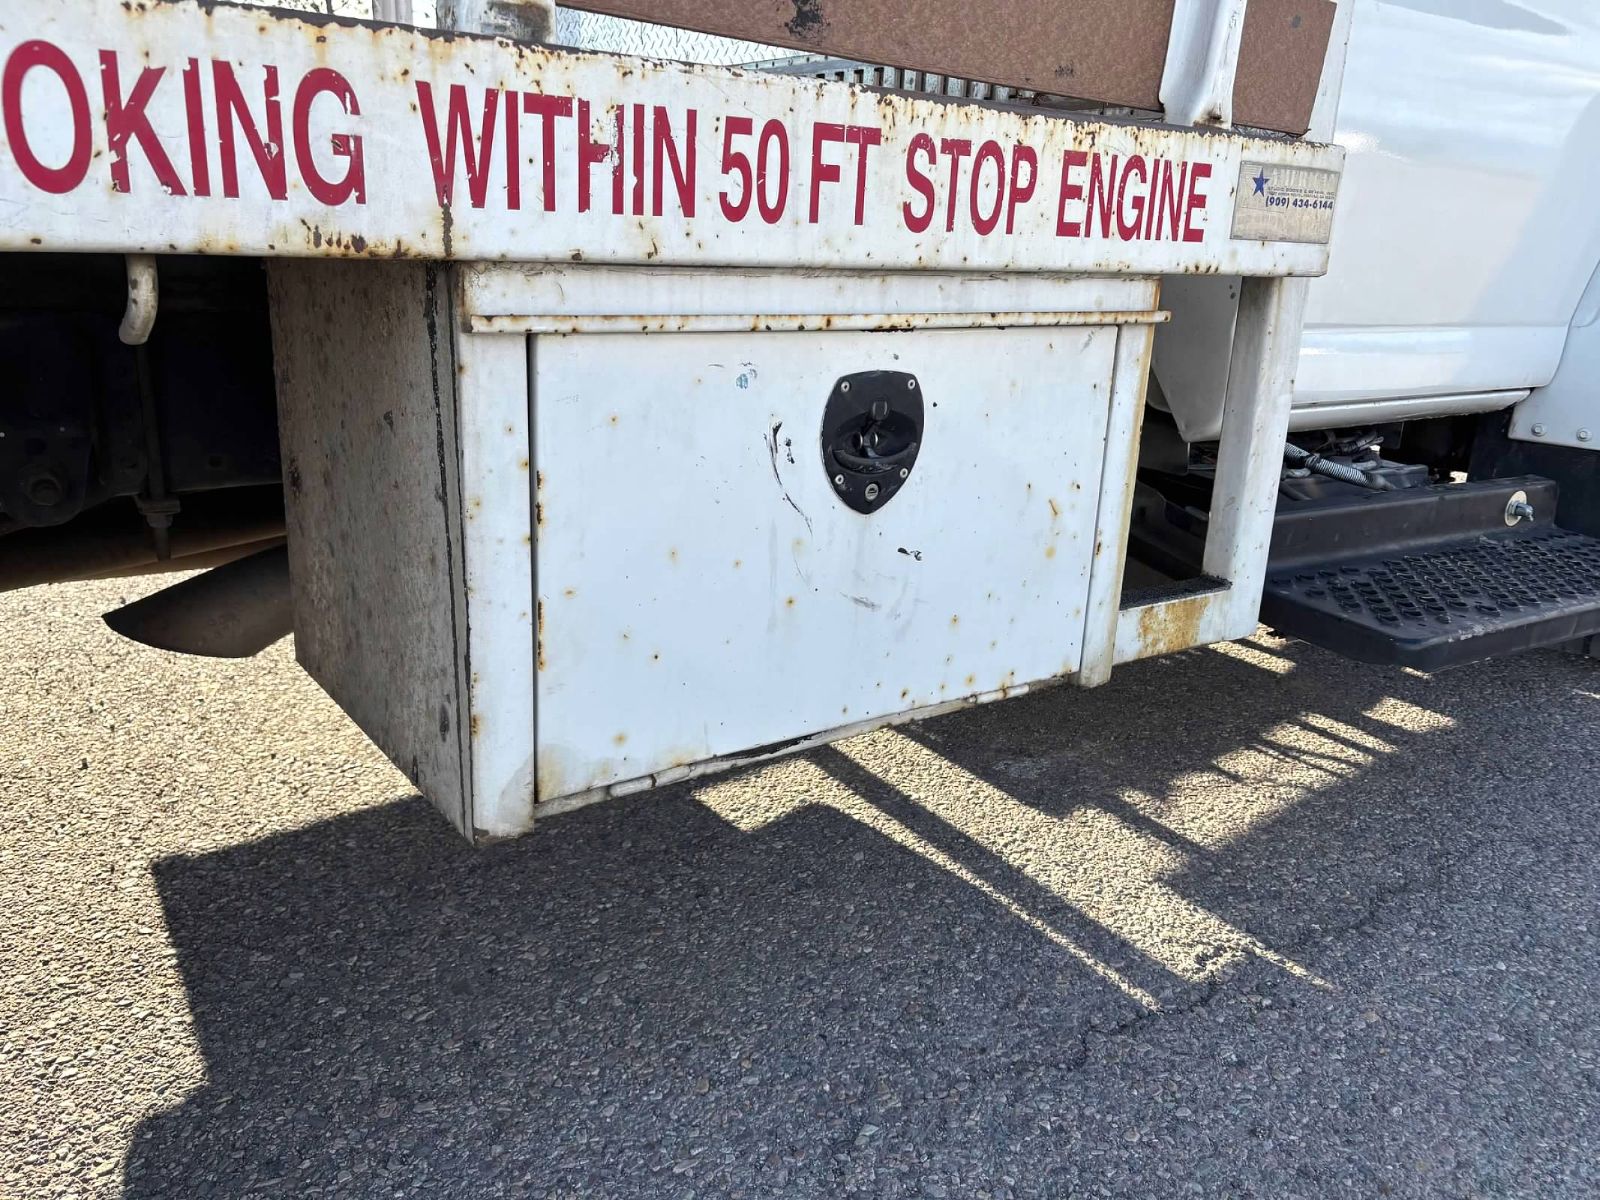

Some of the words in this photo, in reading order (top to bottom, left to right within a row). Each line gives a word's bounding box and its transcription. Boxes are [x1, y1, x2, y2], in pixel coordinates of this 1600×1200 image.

[3, 40, 365, 206] OKING
[416, 80, 697, 218] WITHIN
[719, 117, 789, 224] 50
[810, 122, 881, 224] FT
[903, 133, 1037, 236] STOP
[1057, 151, 1212, 243] ENGINE
[1265, 195, 1290, 209] (909)
